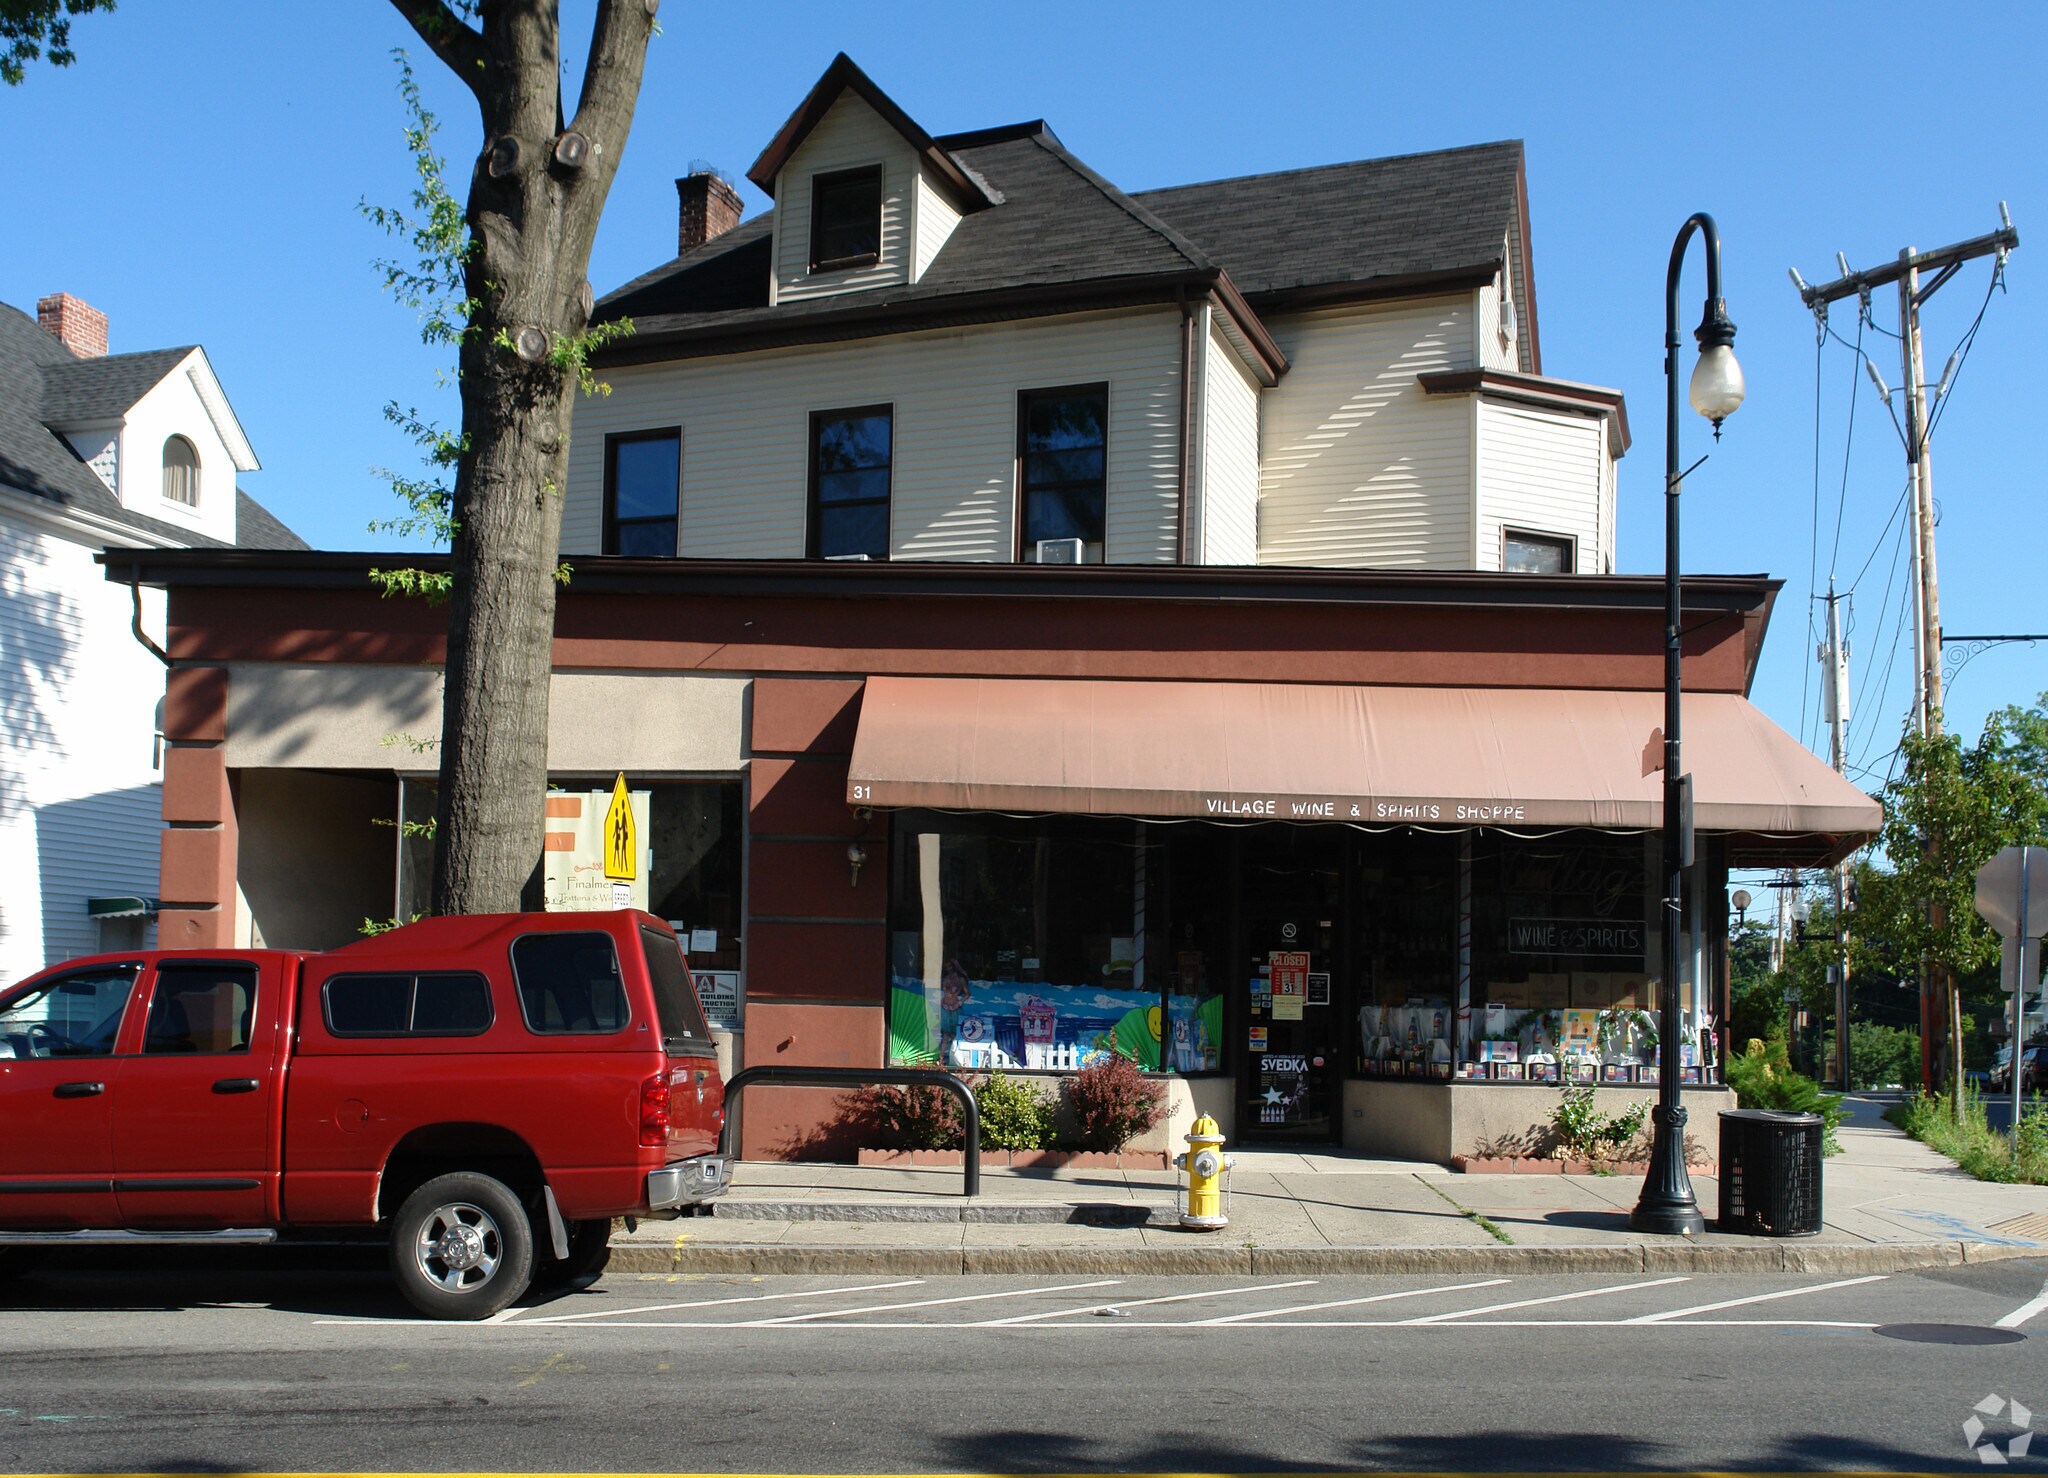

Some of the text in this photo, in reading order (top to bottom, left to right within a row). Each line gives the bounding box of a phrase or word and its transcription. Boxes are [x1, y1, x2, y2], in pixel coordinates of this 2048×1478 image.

[853, 785, 871, 799] 31
[1206, 799, 1525, 820] VILLAGE WINE & SPIRITS SHOPPE
[567, 876, 613, 890] Finalme
[1518, 926, 1556, 947] WINE
[1576, 928, 1639, 948] SPIRITS
[1273, 955, 1306, 966] CLOSED
[1261, 1058, 1309, 1073] SVEDKA
